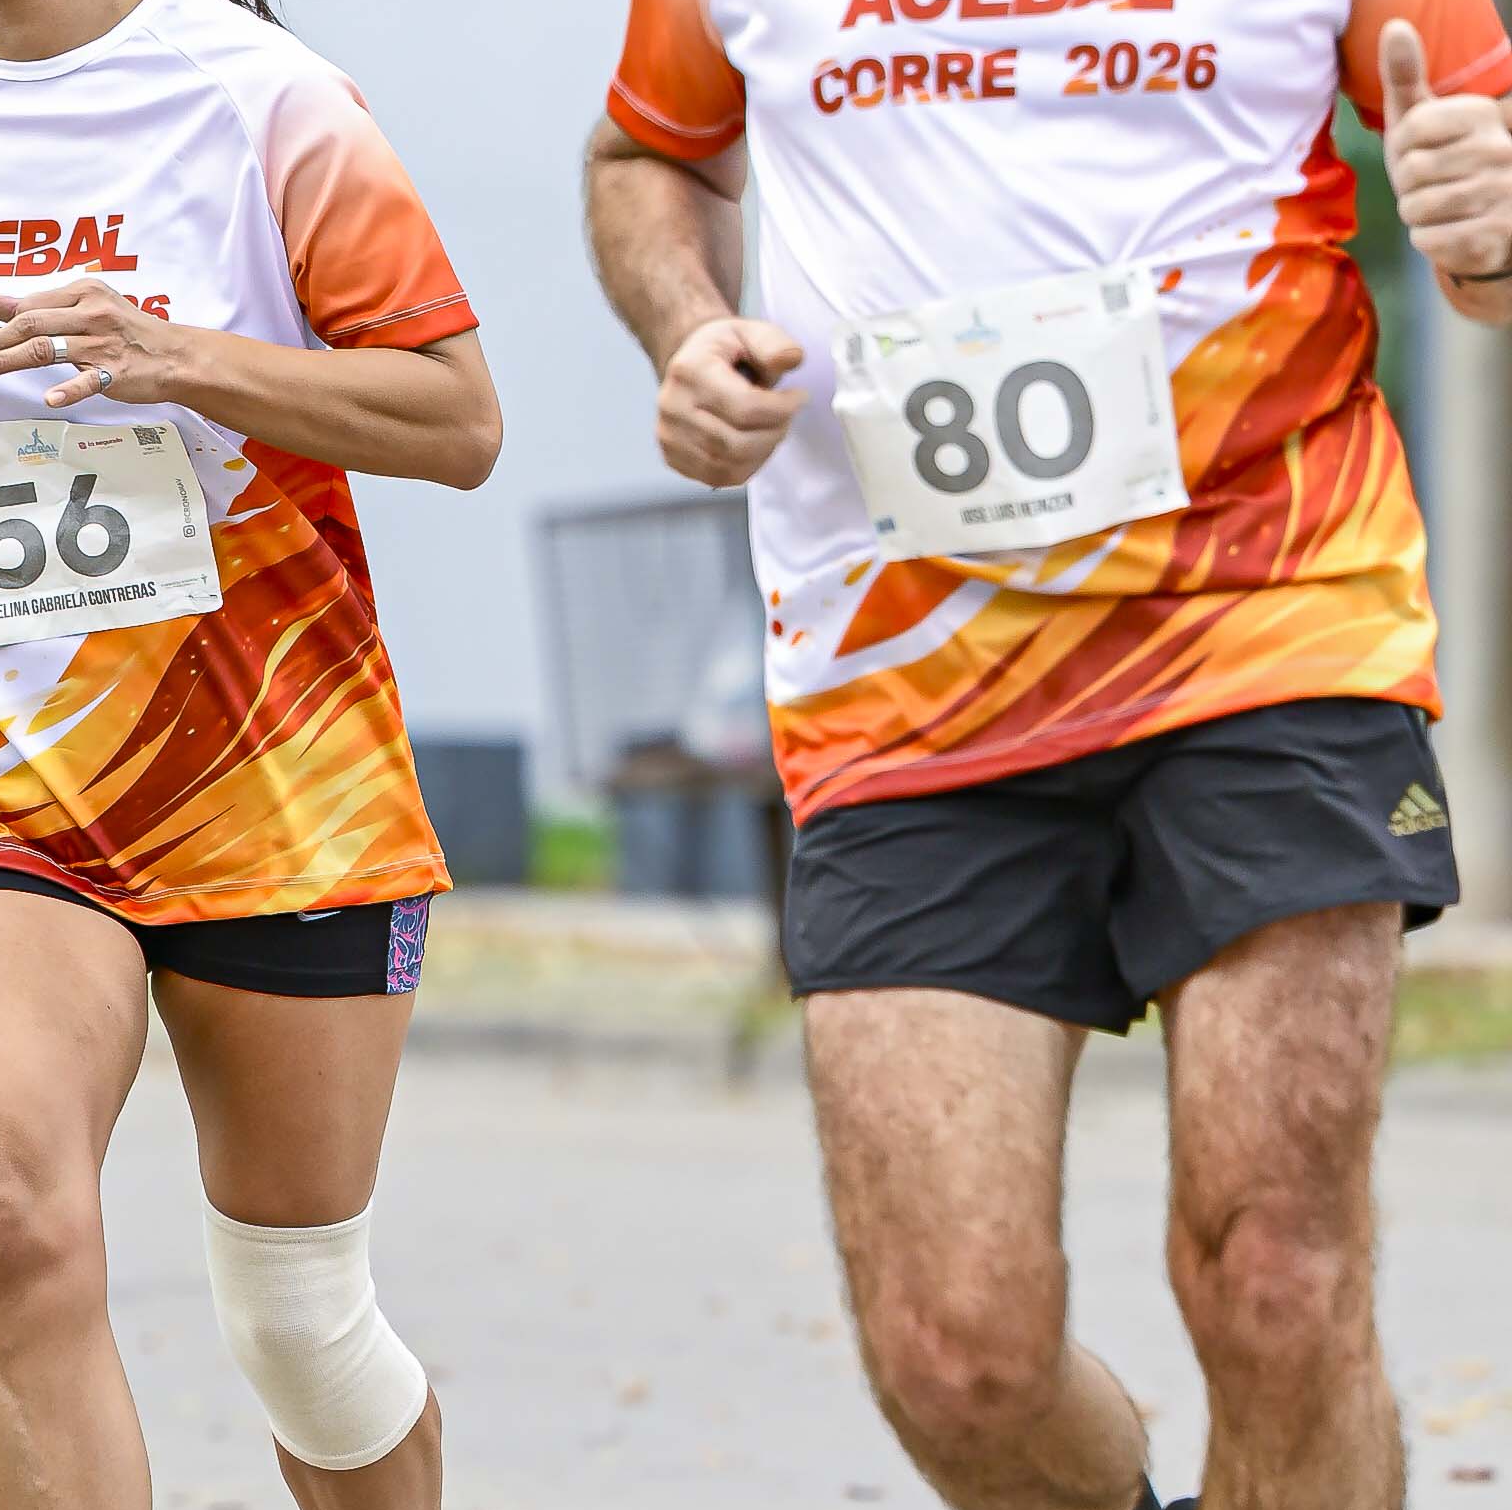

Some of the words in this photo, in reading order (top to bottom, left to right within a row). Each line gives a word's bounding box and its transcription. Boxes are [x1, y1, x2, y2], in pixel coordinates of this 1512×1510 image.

[812, 48, 1017, 114] CORRE
[1064, 41, 1216, 96] 2026
[904, 360, 1094, 494] 80
[31, 592, 87, 614] GABRIELA
[88, 581, 157, 605] CONTRERAS
